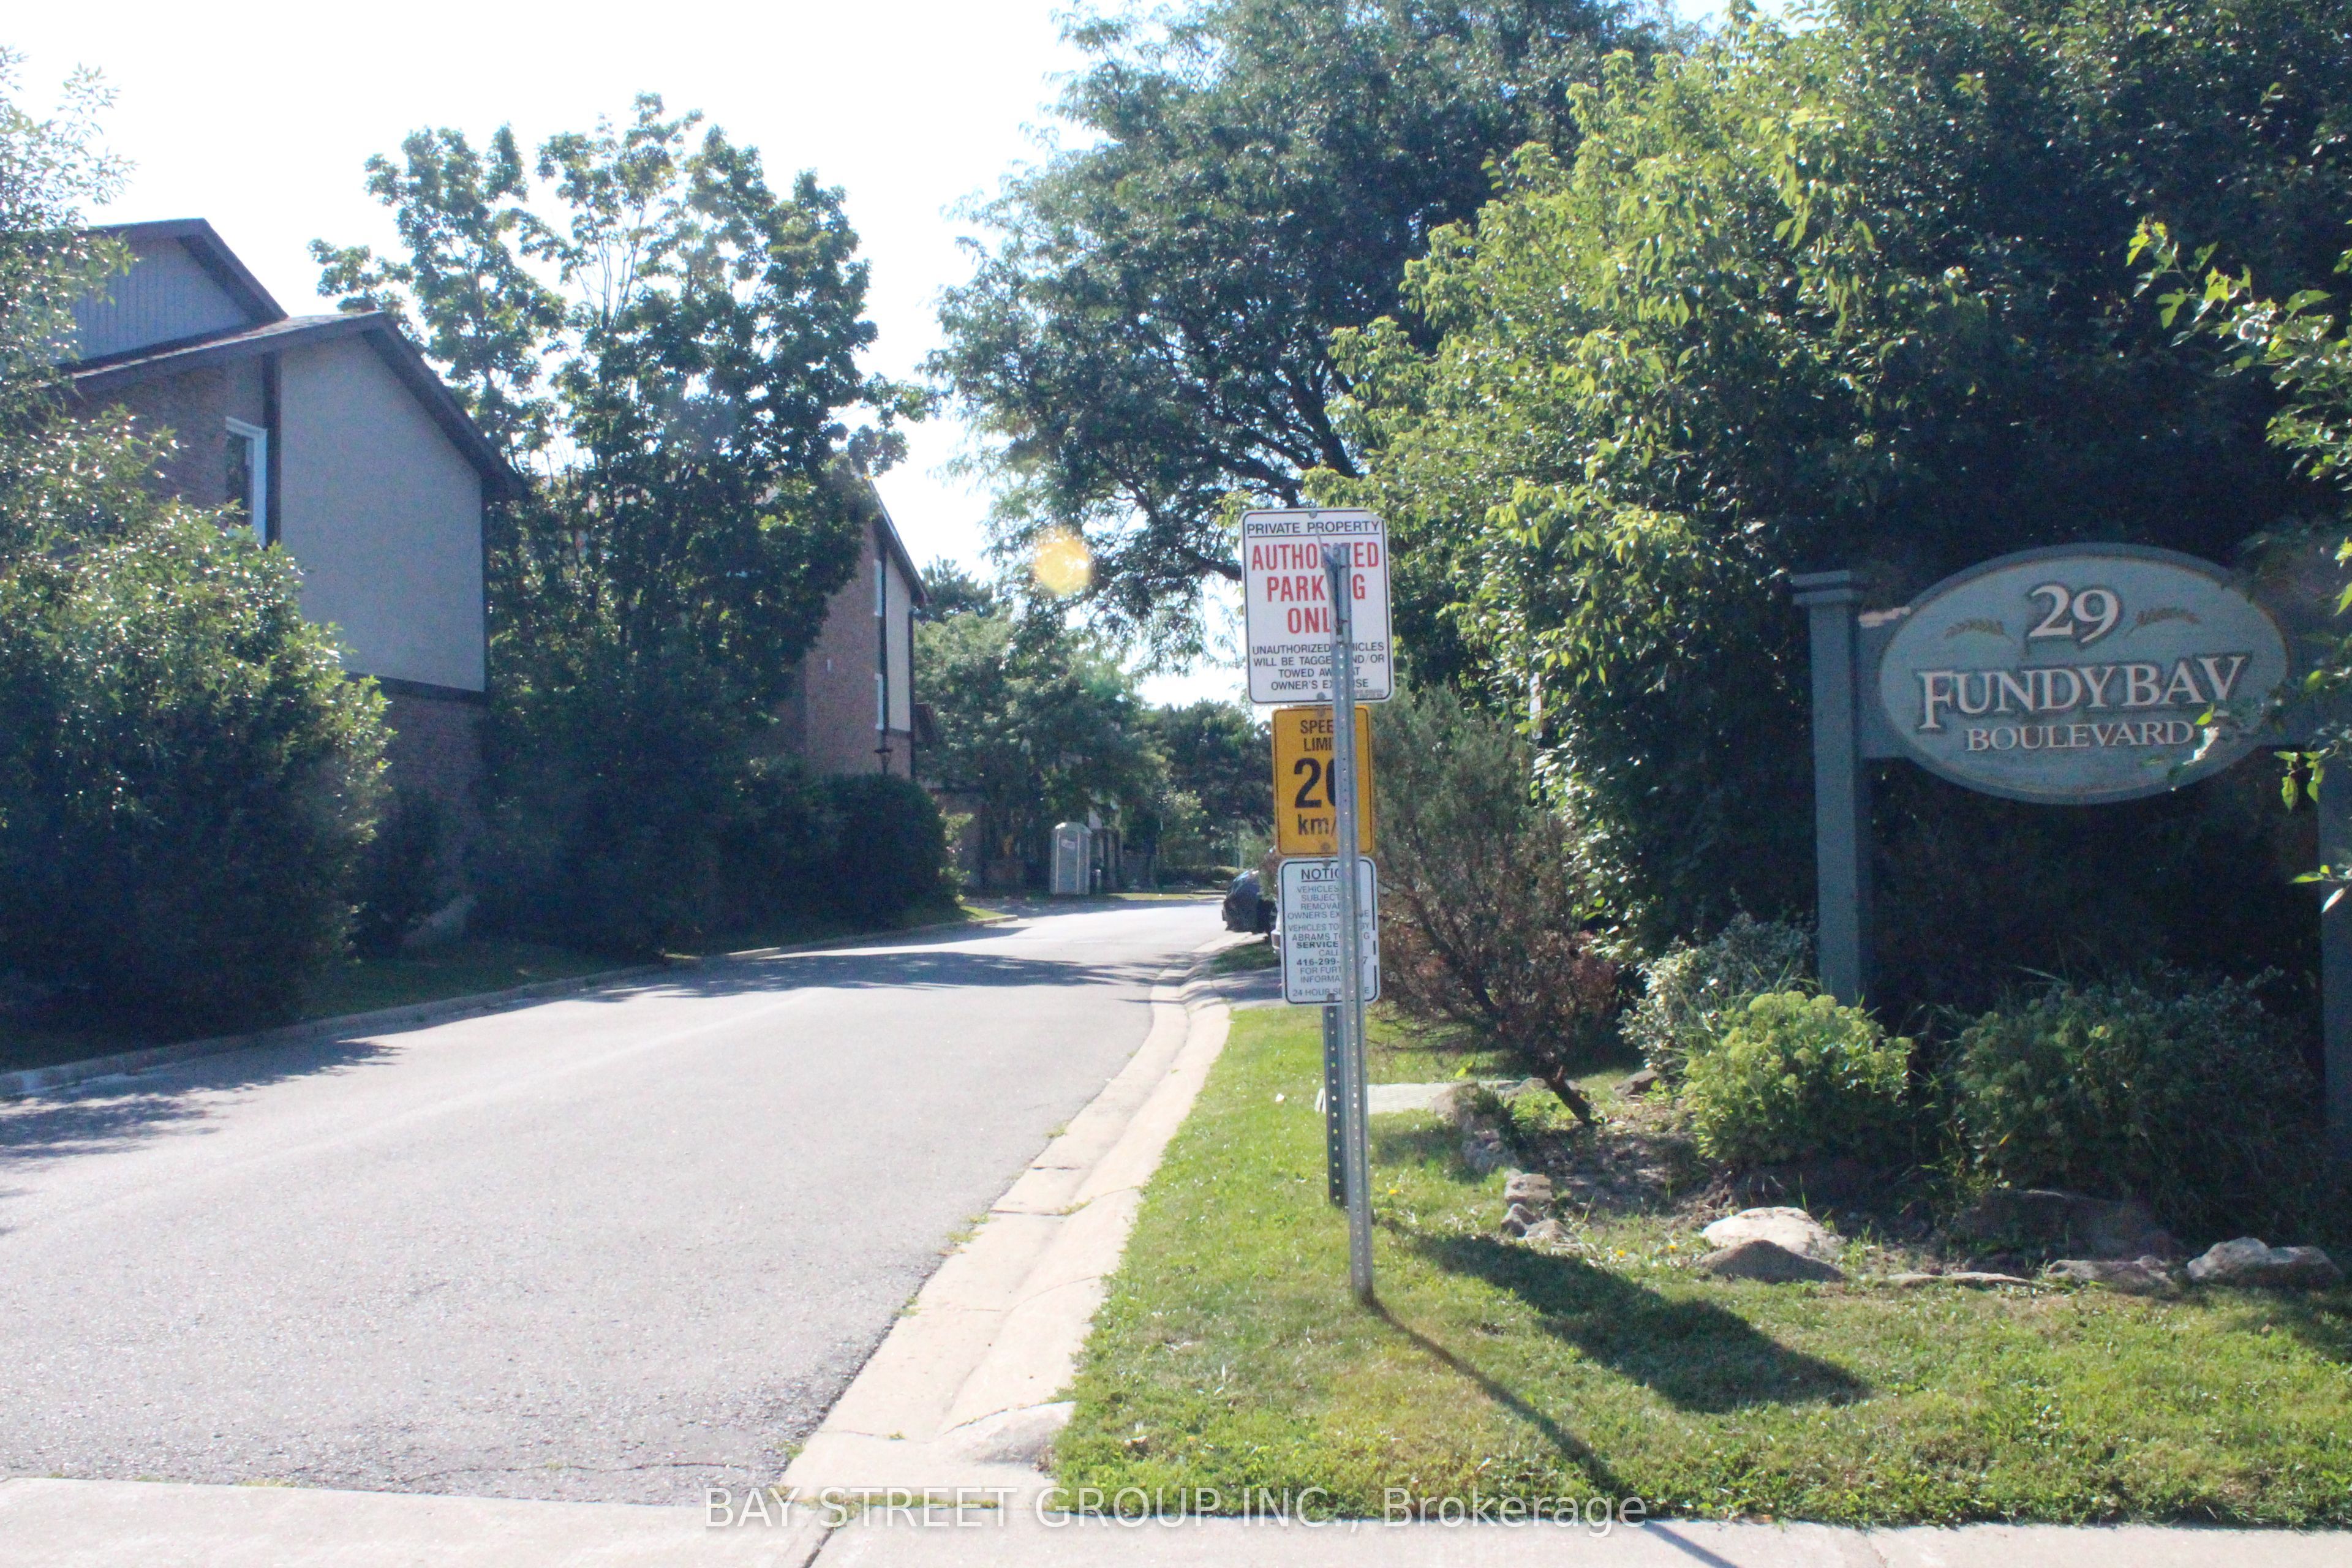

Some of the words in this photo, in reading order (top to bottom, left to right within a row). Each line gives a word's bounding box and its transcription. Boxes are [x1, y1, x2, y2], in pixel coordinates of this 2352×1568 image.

[1247, 522, 1300, 534] PRIVATE
[1307, 521, 1379, 533] PROPERTY
[1267, 573, 1365, 602] PARKG
[1287, 607, 1332, 634] ONL
[2029, 585, 2120, 643] 29
[1253, 644, 1331, 655] UNAUTHORIZED
[1254, 657, 1276, 666] WILL
[1281, 657, 1294, 666] BE
[1299, 655, 1332, 665] TAGGE
[1352, 654, 1385, 663] ND/OR
[1278, 668, 1314, 678] TOWED
[1271, 680, 1318, 690] OWNER'S
[1300, 719, 1333, 734] SPEE
[1965, 721, 2195, 752] BOULEVARD
[1303, 737, 1333, 752] LIMI
[1292, 933, 1330, 941] ABRAMS
